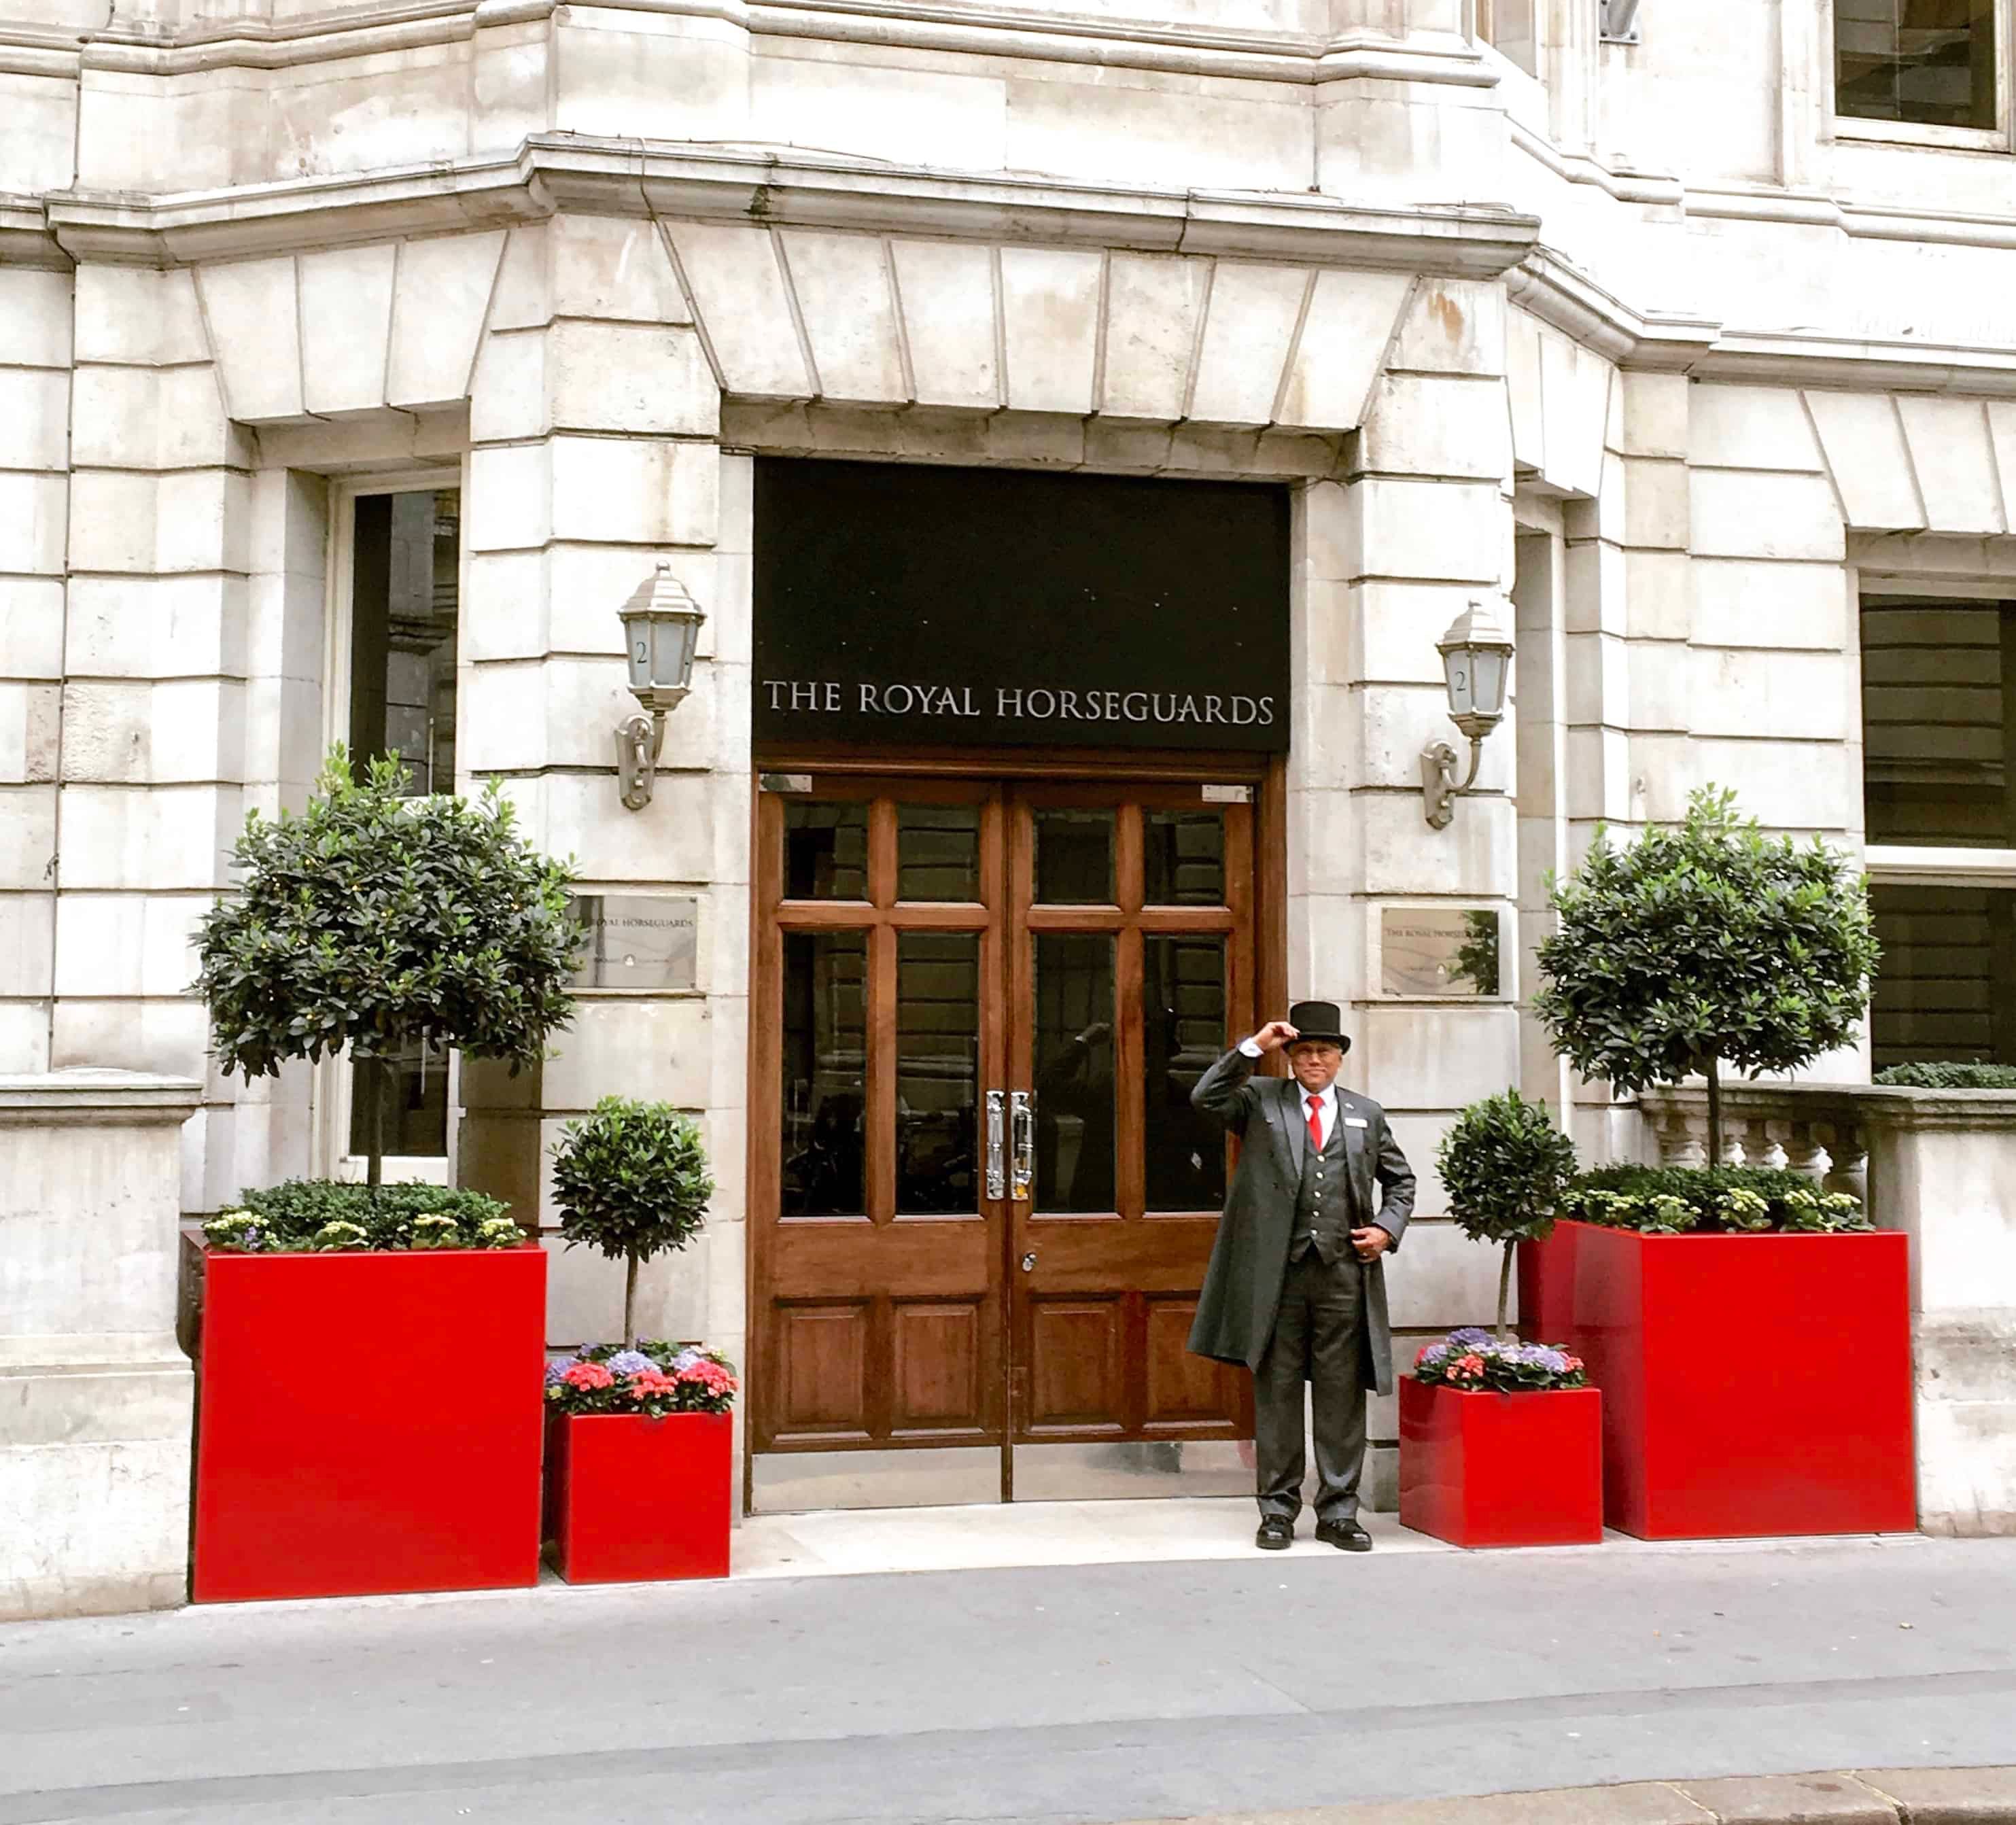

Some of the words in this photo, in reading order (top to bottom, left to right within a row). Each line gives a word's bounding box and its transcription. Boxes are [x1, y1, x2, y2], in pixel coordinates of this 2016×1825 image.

[636, 641, 647, 664] 2
[1455, 671, 1466, 692] 2
[763, 680, 841, 711] THE
[858, 684, 981, 716] ROYAL
[995, 688, 1274, 725] HORSEGUARDS
